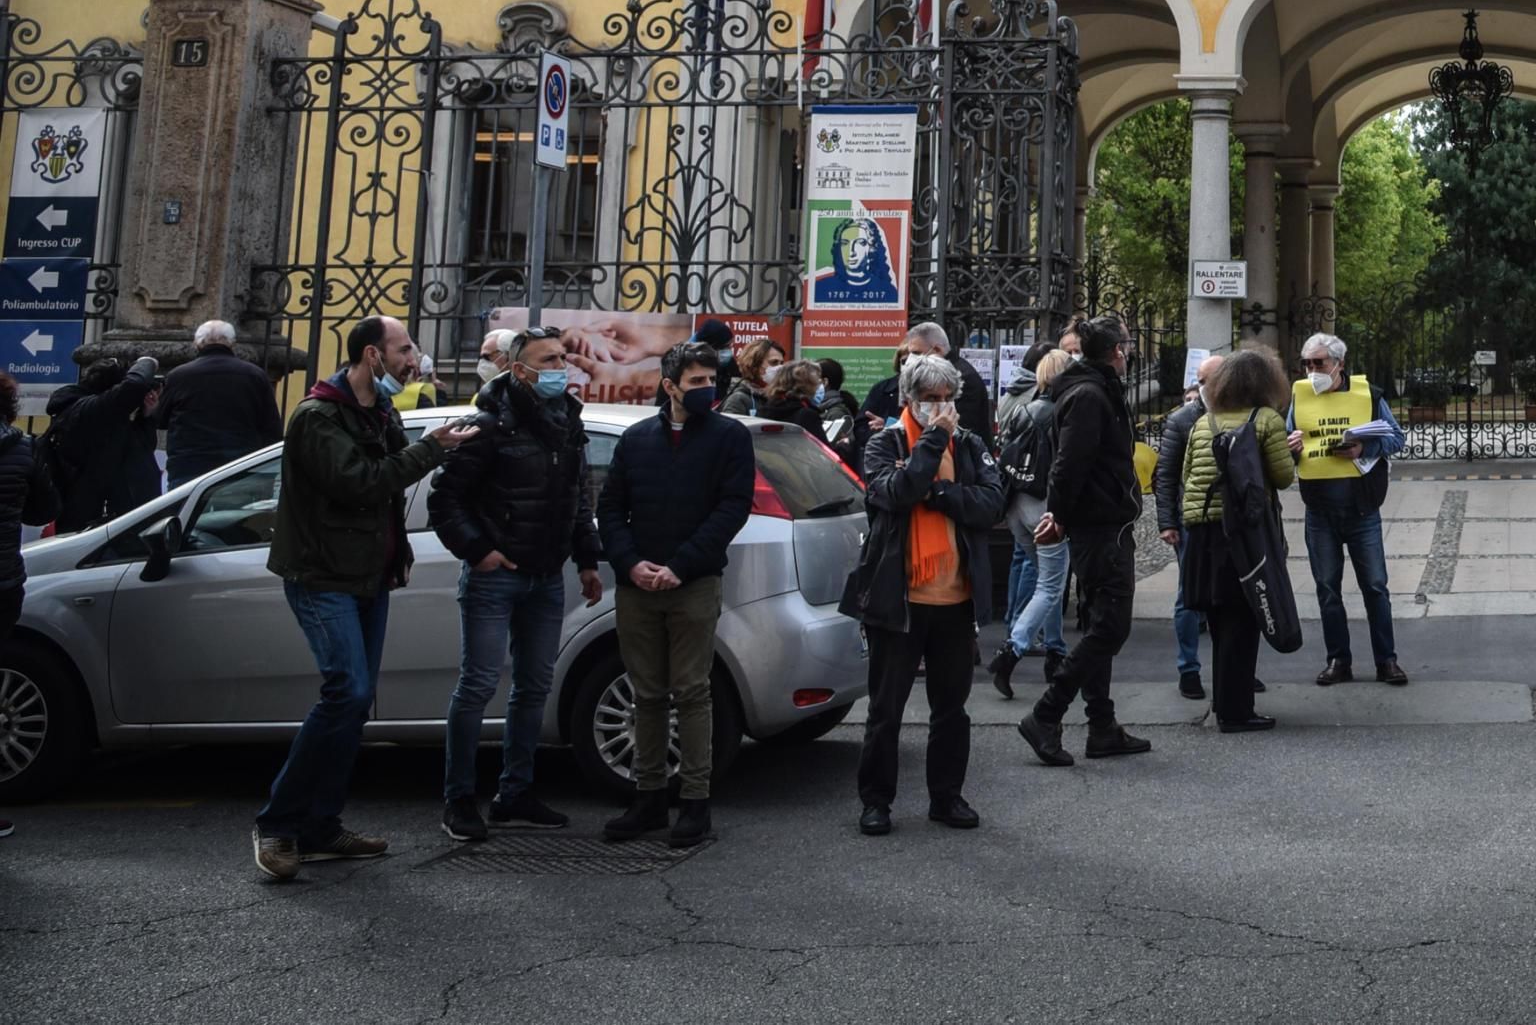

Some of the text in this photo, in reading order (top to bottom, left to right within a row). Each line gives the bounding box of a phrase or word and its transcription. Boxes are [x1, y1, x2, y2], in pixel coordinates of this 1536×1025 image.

[179, 42, 203, 64] 15
[868, 208, 903, 216] Trivulzio
[17, 237, 82, 250] Ingresso CUP
[1195, 270, 1243, 278] RALLENTARE
[863, 291, 886, 299] 2017
[2, 299, 79, 310] Poliambulatorio
[732, 321, 769, 332] TUTELA
[8, 363, 60, 375] Radiologia
[1318, 417, 1350, 426] LA SALUTE
